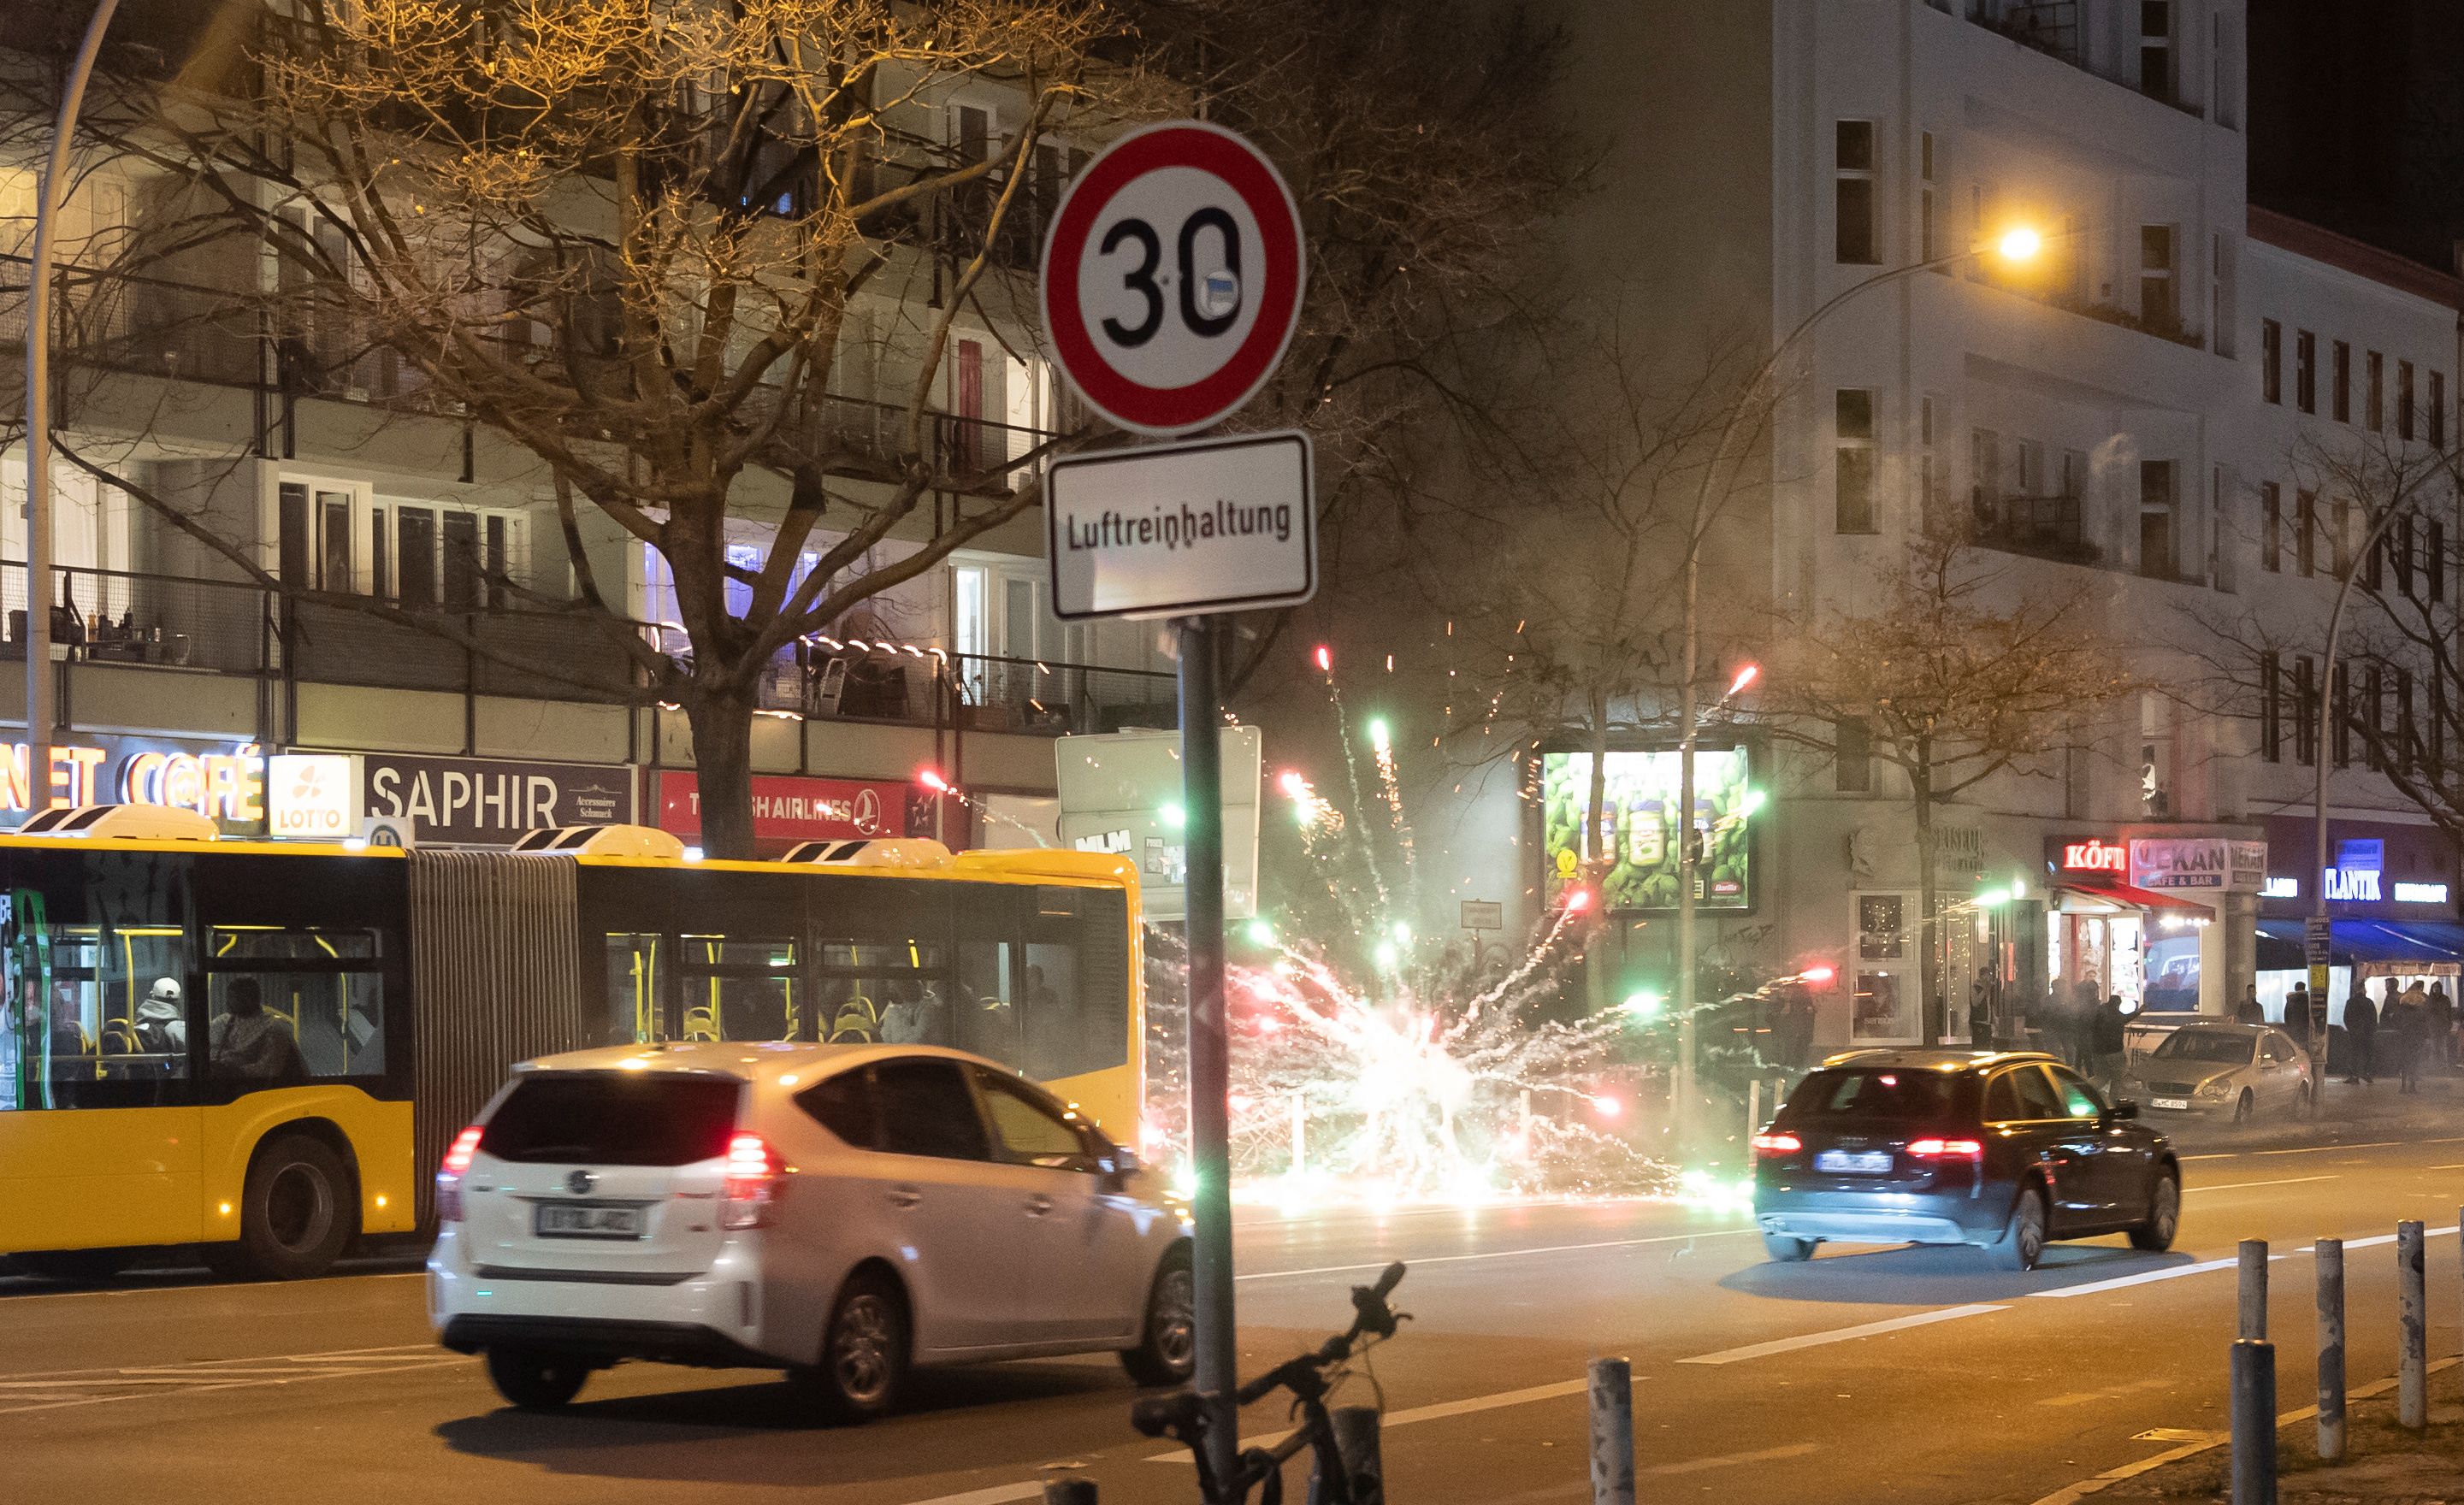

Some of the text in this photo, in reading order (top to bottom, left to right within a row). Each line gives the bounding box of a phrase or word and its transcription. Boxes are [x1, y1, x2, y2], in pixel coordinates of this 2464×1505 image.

[1100, 206, 1243, 348] 30
[1067, 499, 1291, 552] Luftreinhaltung
[371, 767, 559, 829] SAPHIR
[771, 795, 852, 823] AIRLINES
[280, 808, 340, 829] LOTTO
[2189, 876, 2213, 886] BAR
